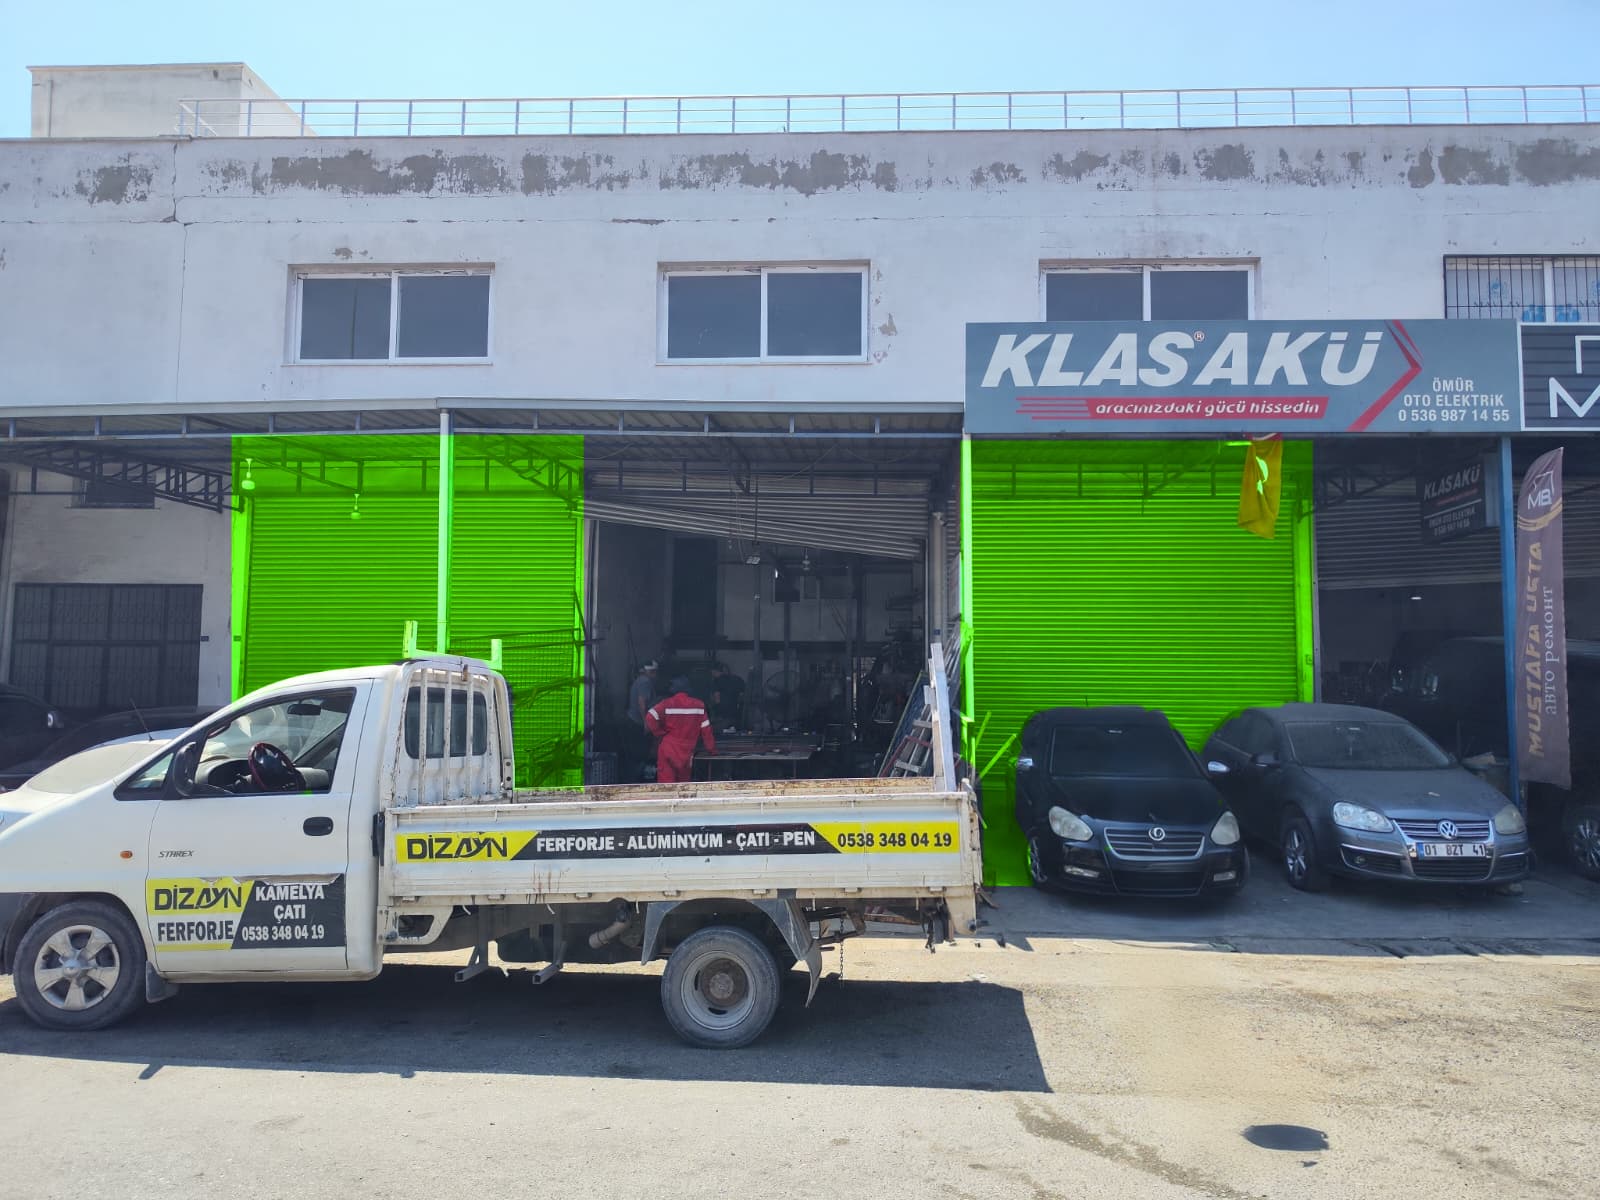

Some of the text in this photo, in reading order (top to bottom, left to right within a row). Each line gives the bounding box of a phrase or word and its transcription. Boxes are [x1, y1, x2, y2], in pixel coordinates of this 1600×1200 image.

[1432, 376, 1475, 392] ÖMÜR
[1204, 401, 1246, 417] gücü
[1250, 400, 1320, 414] hissedin
[1403, 394, 1432, 407] OTO
[1398, 409, 1510, 421] 0 536 987 14 55
[1526, 541, 1545, 758] MUSTAFA USTA
[1543, 586, 1560, 715] авто ремонт
[406, 834, 508, 860] DİZAYN
[536, 835, 615, 853] FERFORJE
[627, 831, 723, 850] ALÜMİNYUM
[736, 832, 770, 851] ÇATI
[783, 831, 816, 847] PEN
[837, 833, 875, 847] 0538
[879, 833, 906, 847] 348
[911, 833, 930, 847] 04
[934, 832, 952, 847] 19
[1424, 844, 1438, 856] 01
[1472, 843, 1485, 856] 41
[154, 885, 242, 911] DİZAYN
[255, 884, 325, 902] KAMELYA
[273, 904, 306, 924] ÇATI
[157, 920, 234, 942] FERFORJE
[241, 924, 325, 941] 0538 348 04 19
